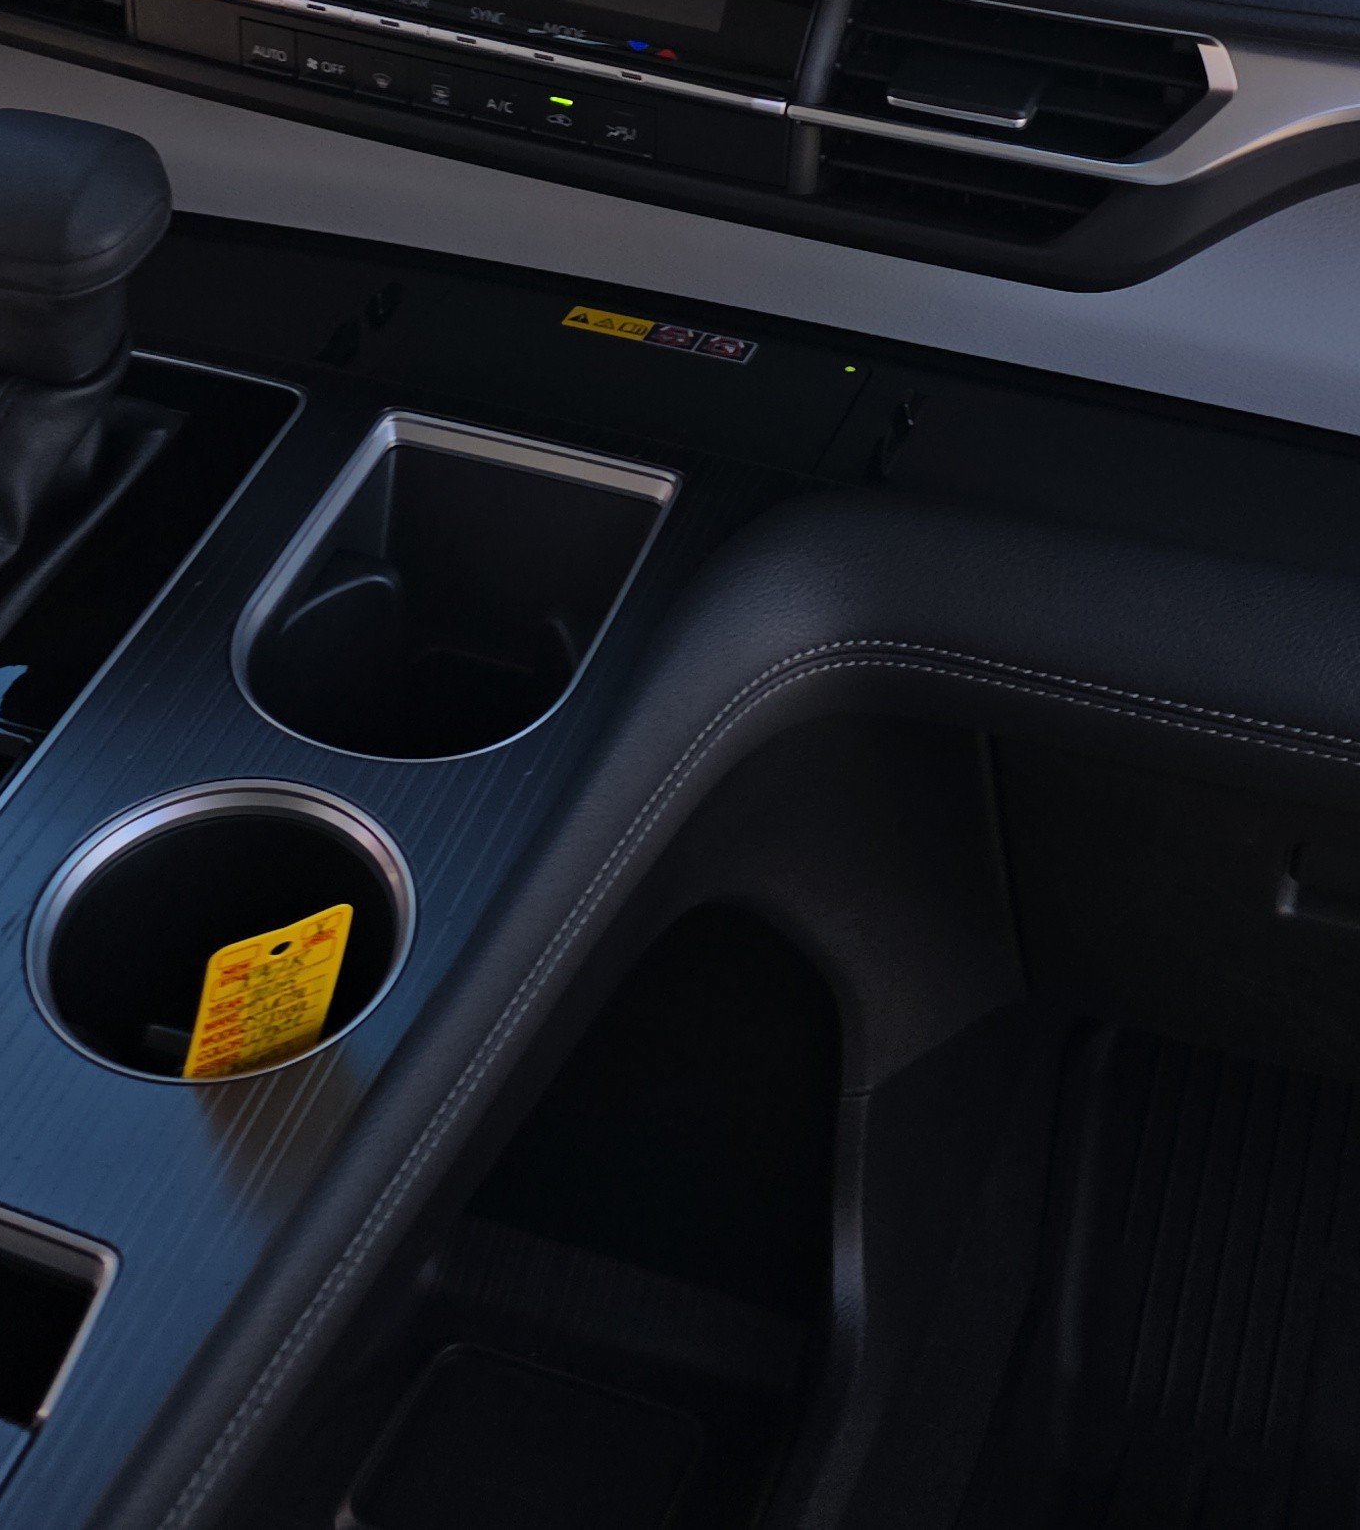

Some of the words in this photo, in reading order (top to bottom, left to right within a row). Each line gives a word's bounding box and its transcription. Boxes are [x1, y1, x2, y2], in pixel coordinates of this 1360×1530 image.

[251, 44, 288, 63] AUTO
[319, 60, 346, 76] OFF
[486, 97, 514, 115] A/C
